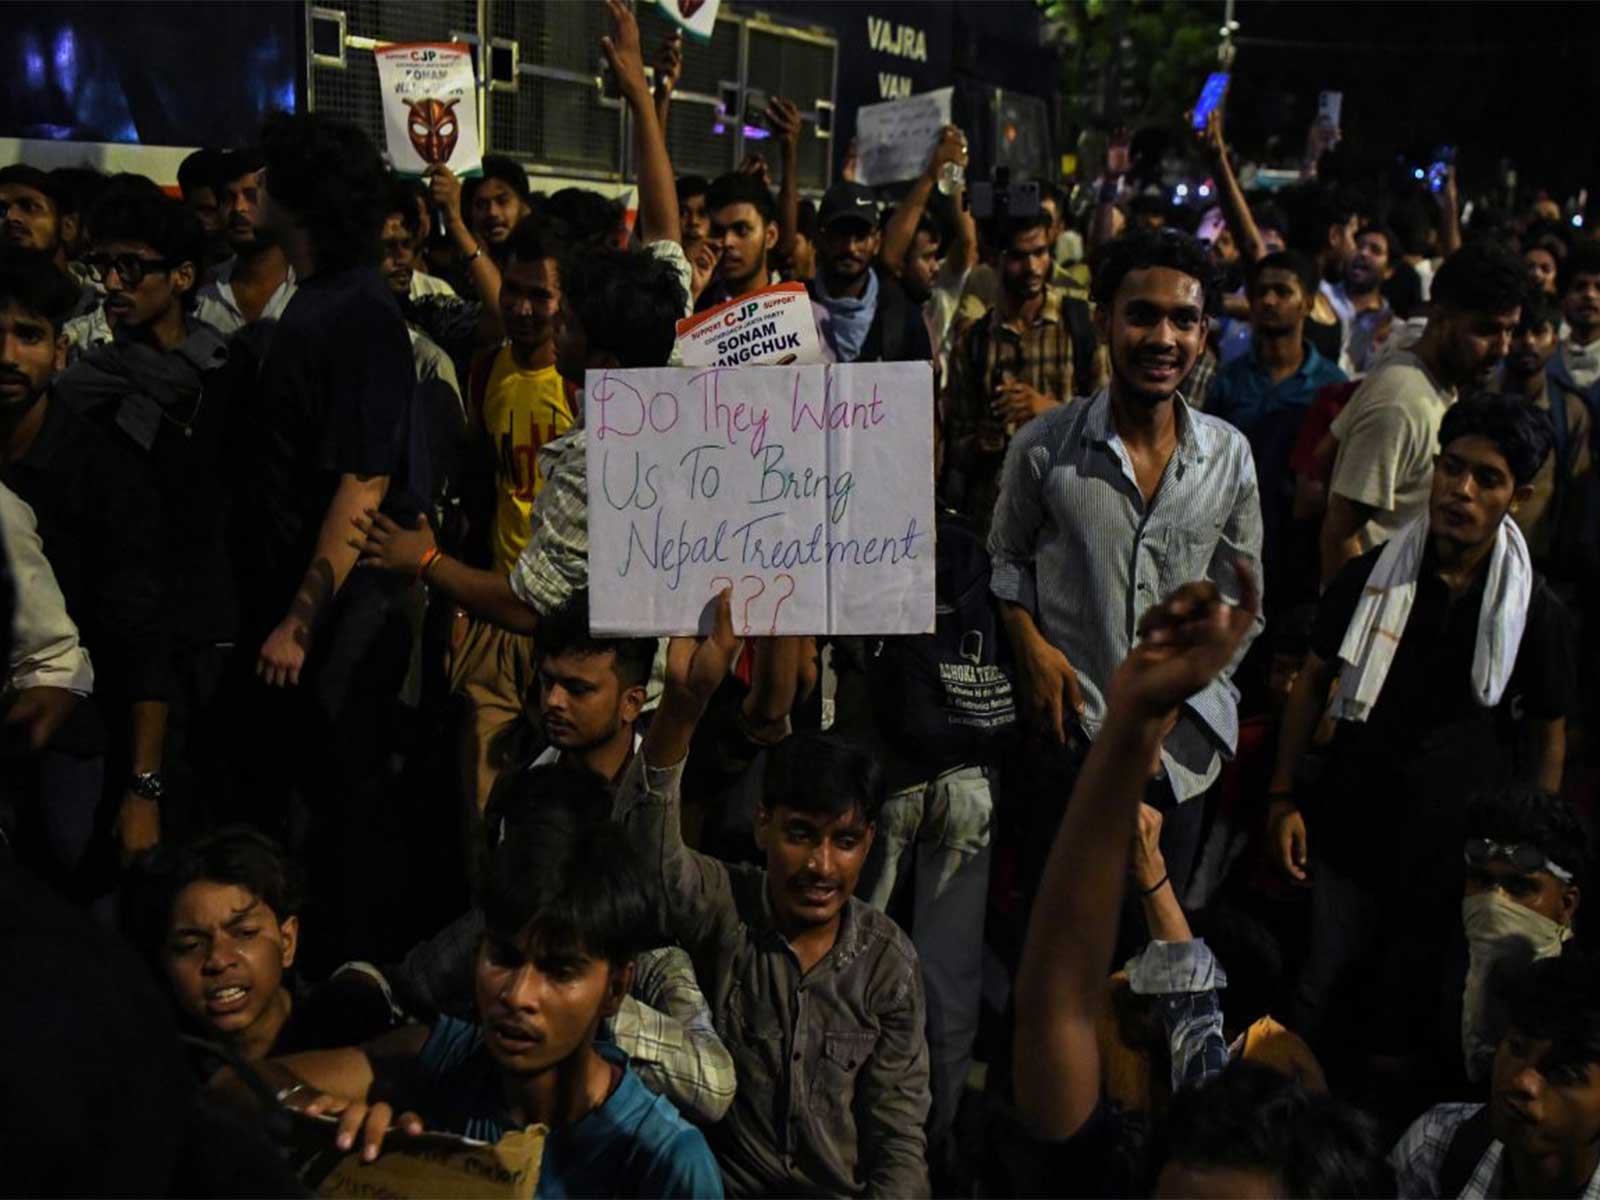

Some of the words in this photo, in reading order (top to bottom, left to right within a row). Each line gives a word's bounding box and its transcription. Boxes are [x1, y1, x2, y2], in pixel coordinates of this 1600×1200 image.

[411, 51, 436, 61] CJP
[867, 15, 928, 63] VAJRA
[878, 72, 912, 99] VAN
[692, 322, 721, 341] SUPPORT
[724, 302, 759, 327] CJP
[763, 296, 796, 309] SUPPORT
[717, 322, 777, 354] SONAM
[687, 369, 770, 459] They
[791, 371, 886, 435] Want
[748, 445, 856, 525] Bring
[618, 506, 728, 591] Nepal
[732, 511, 927, 570] Treatment
